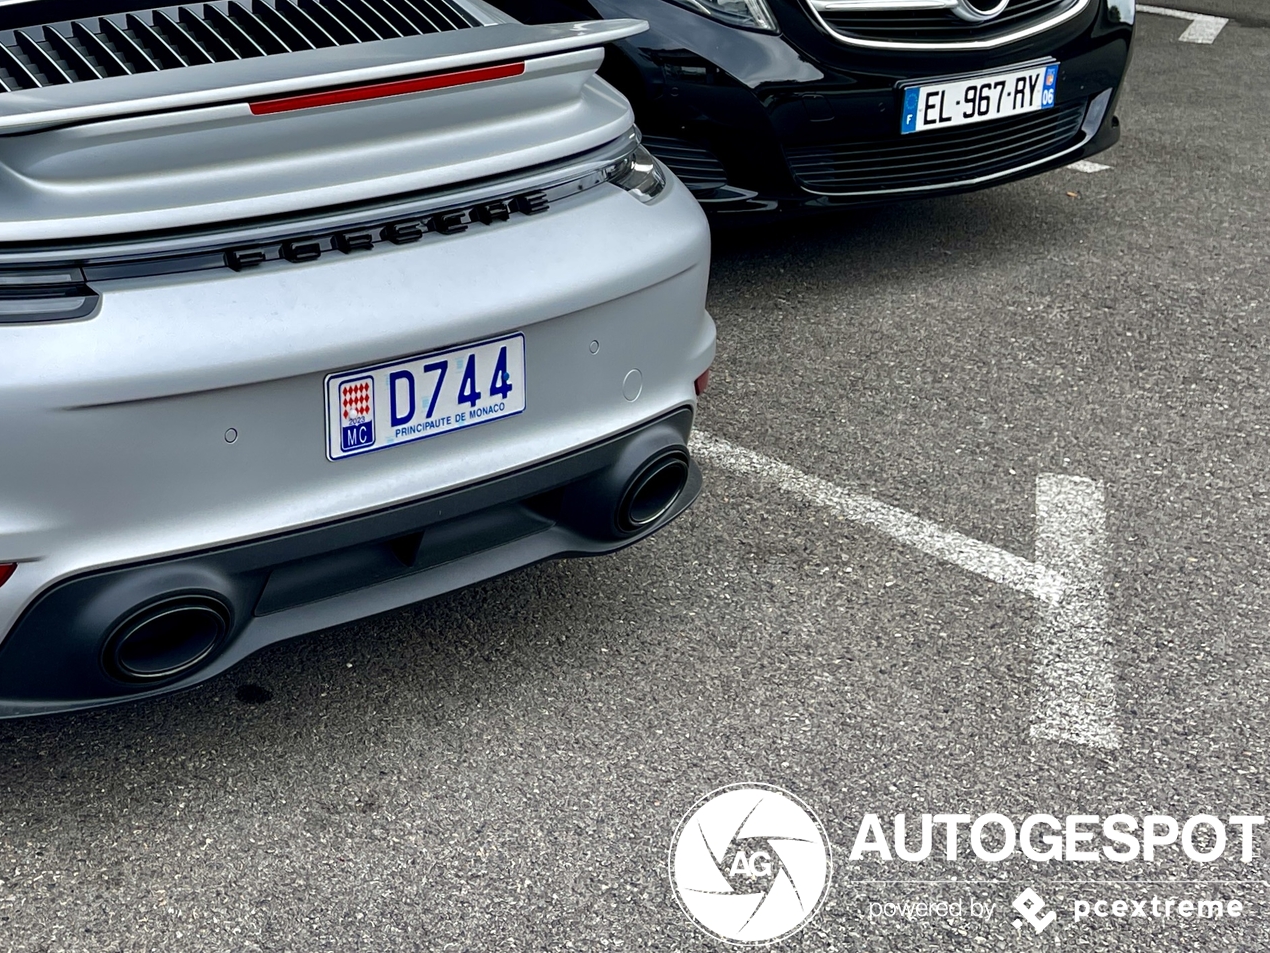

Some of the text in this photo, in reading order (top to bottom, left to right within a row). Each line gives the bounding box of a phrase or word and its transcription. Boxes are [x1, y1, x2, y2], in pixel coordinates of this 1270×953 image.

[1042, 88, 1054, 105] 06
[906, 114, 913, 125] F
[389, 346, 513, 427] D744
[395, 402, 506, 438] PRINCIPAUTE DE MONACO
[347, 426, 368, 446] MC
